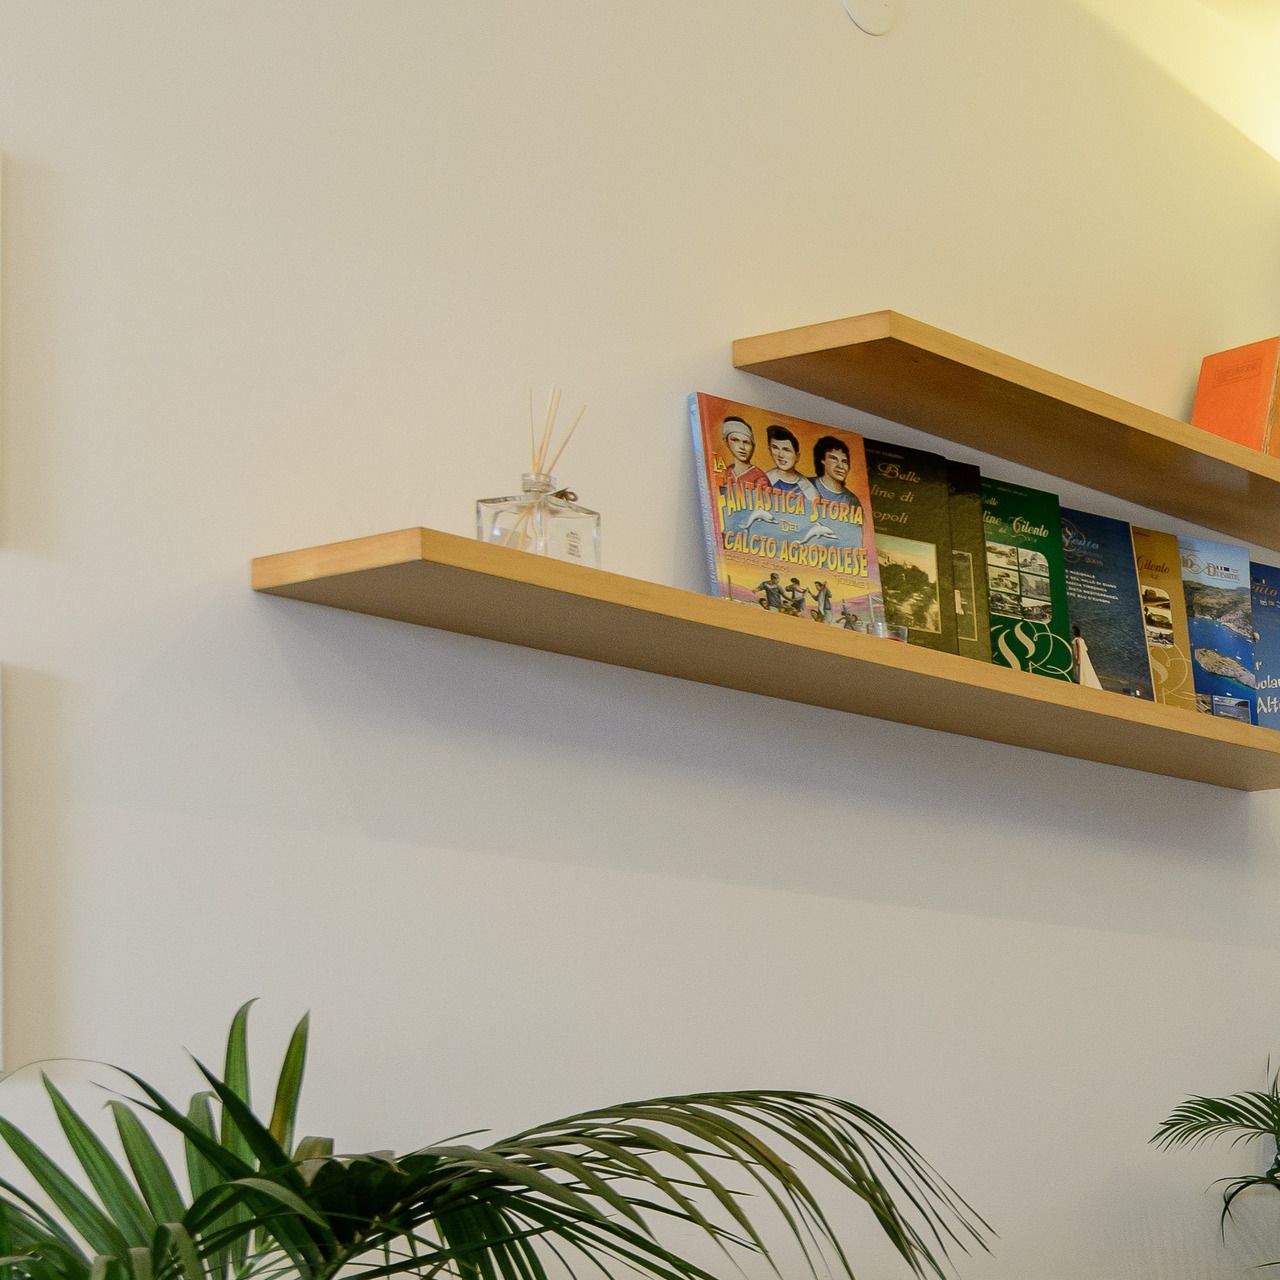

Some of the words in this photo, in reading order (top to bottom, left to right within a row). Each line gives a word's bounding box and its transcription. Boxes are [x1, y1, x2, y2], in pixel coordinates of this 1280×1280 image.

[712, 452, 727, 473] LA
[714, 473, 806, 533] FANTASTICA
[810, 497, 864, 525] STORIA
[871, 484, 896, 499] line
[900, 491, 915, 503] di
[873, 511, 909, 524] opoli
[983, 510, 1003, 526] line
[1011, 516, 1049, 538] Cilento
[724, 530, 777, 559] CALCIO
[780, 539, 869, 577] AGROPOLESE
